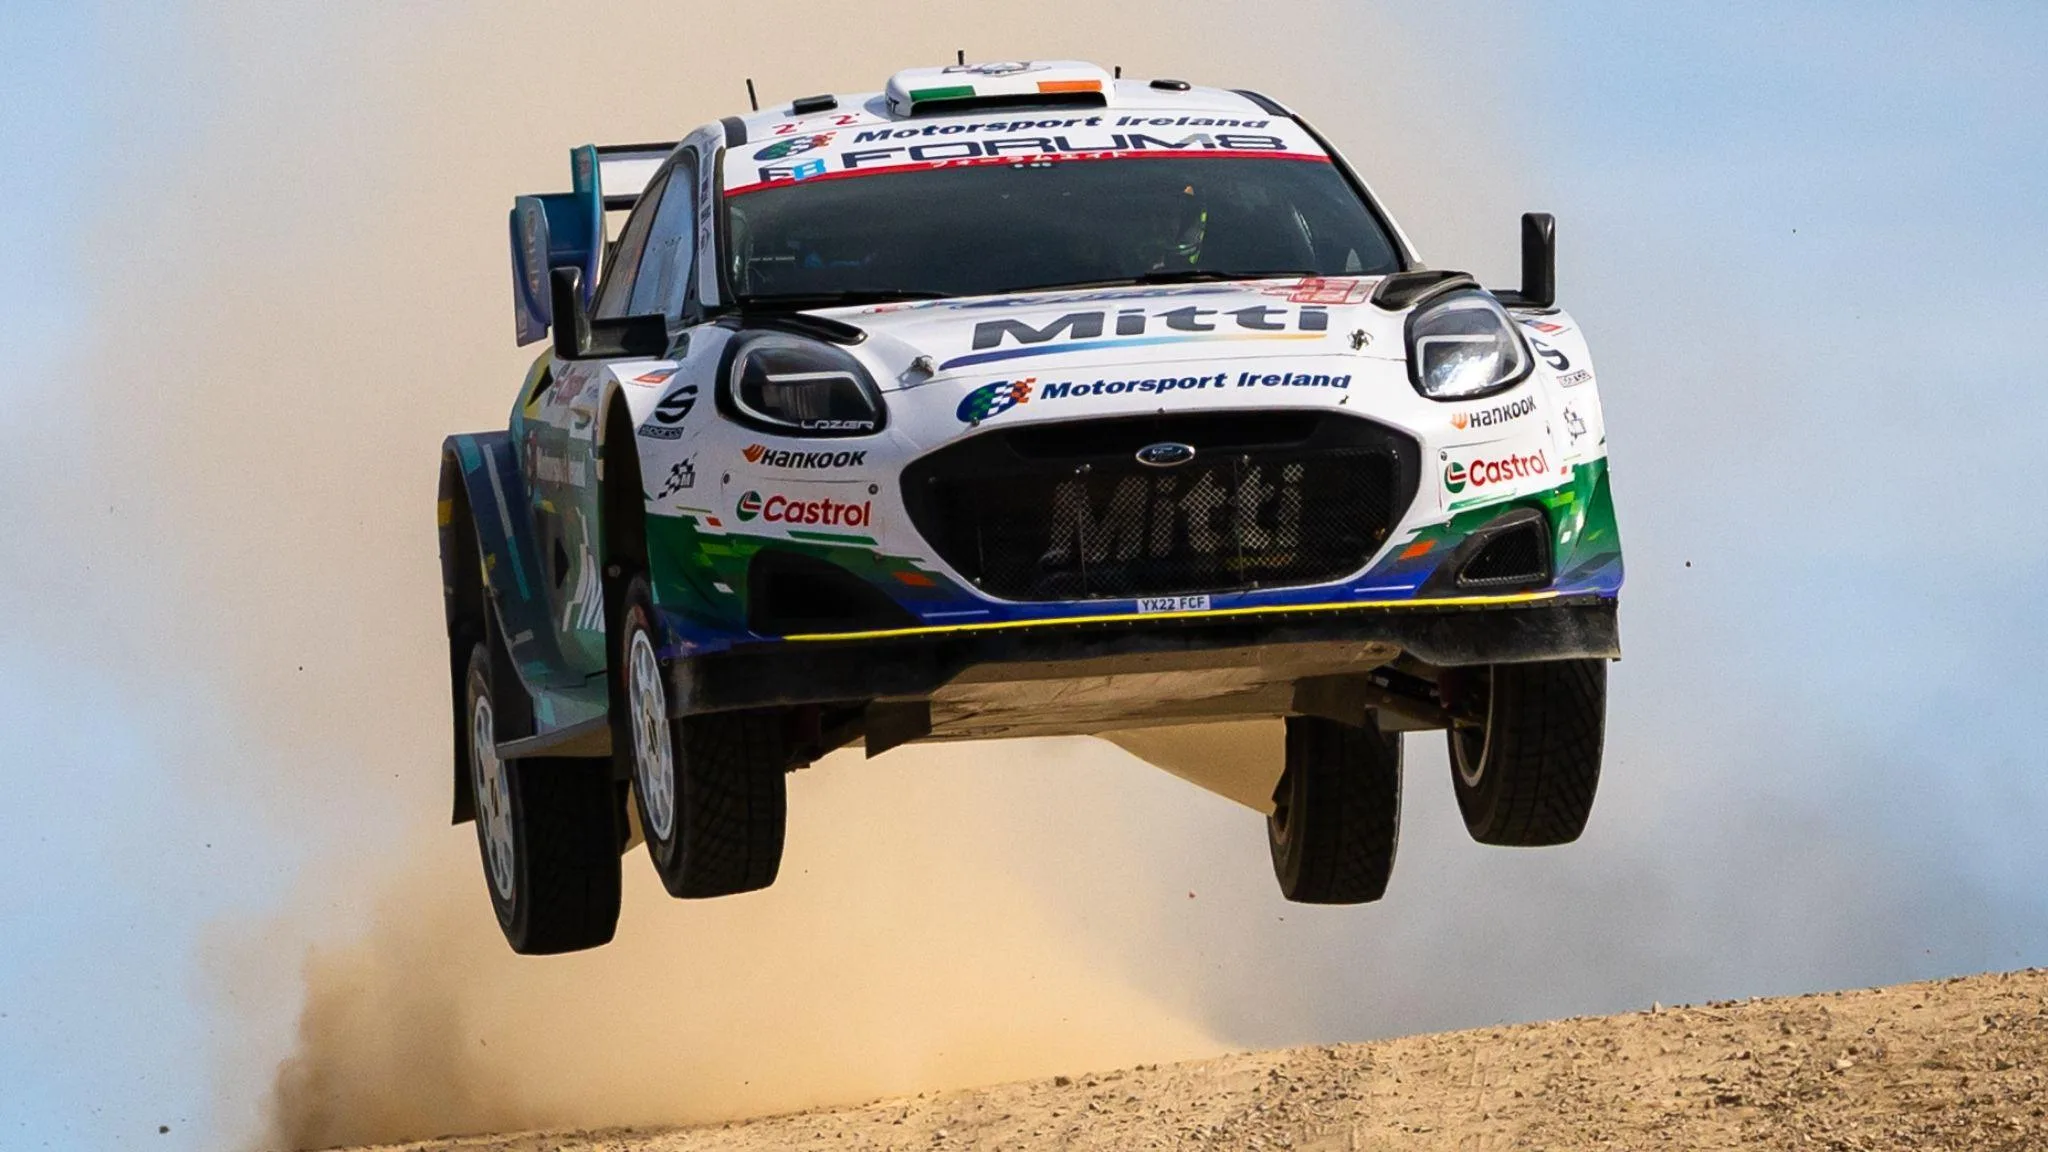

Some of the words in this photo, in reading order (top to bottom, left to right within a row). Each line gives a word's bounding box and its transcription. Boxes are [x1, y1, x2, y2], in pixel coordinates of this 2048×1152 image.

[853, 115, 1103, 143] Motorsport
[1116, 115, 1271, 129] Ireland
[841, 133, 1287, 169] FORUM8
[972, 305, 1328, 351] Mitti
[1040, 372, 1226, 400] Motorsport
[1237, 372, 1351, 389] Ireland
[1469, 449, 1550, 487] Castrol
[763, 495, 871, 526] Castrol
[1049, 463, 1304, 562] Mitti
[1142, 598, 1175, 611] YX22
[1180, 596, 1205, 609] FCF
